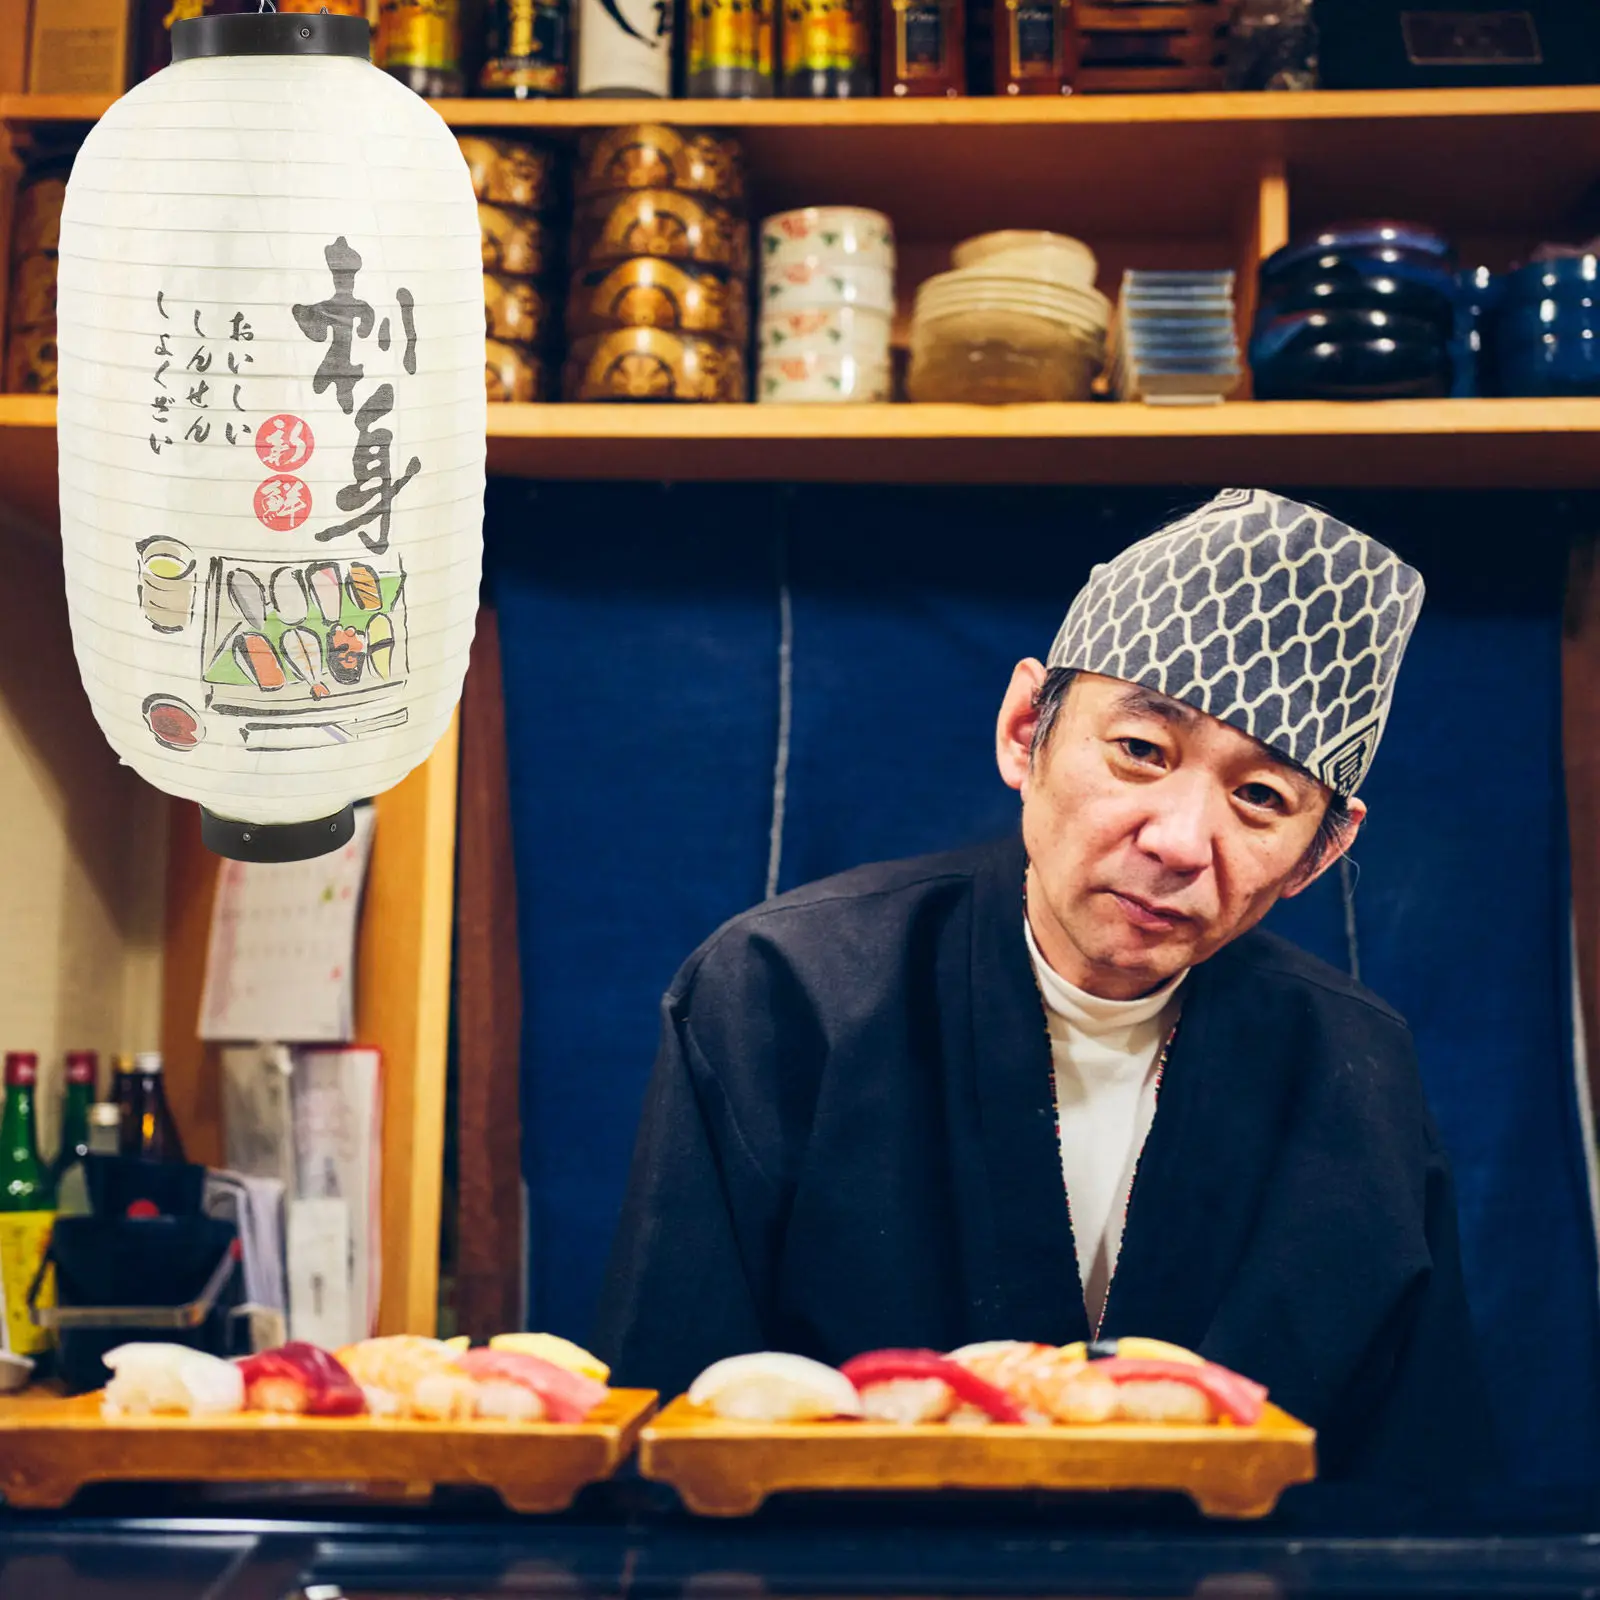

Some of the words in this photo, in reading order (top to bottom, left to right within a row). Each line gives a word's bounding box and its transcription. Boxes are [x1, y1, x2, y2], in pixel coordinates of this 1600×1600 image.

[184, 309, 213, 444] しんせん
[225, 311, 255, 446] おいしい
[292, 236, 421, 555] 刺身
